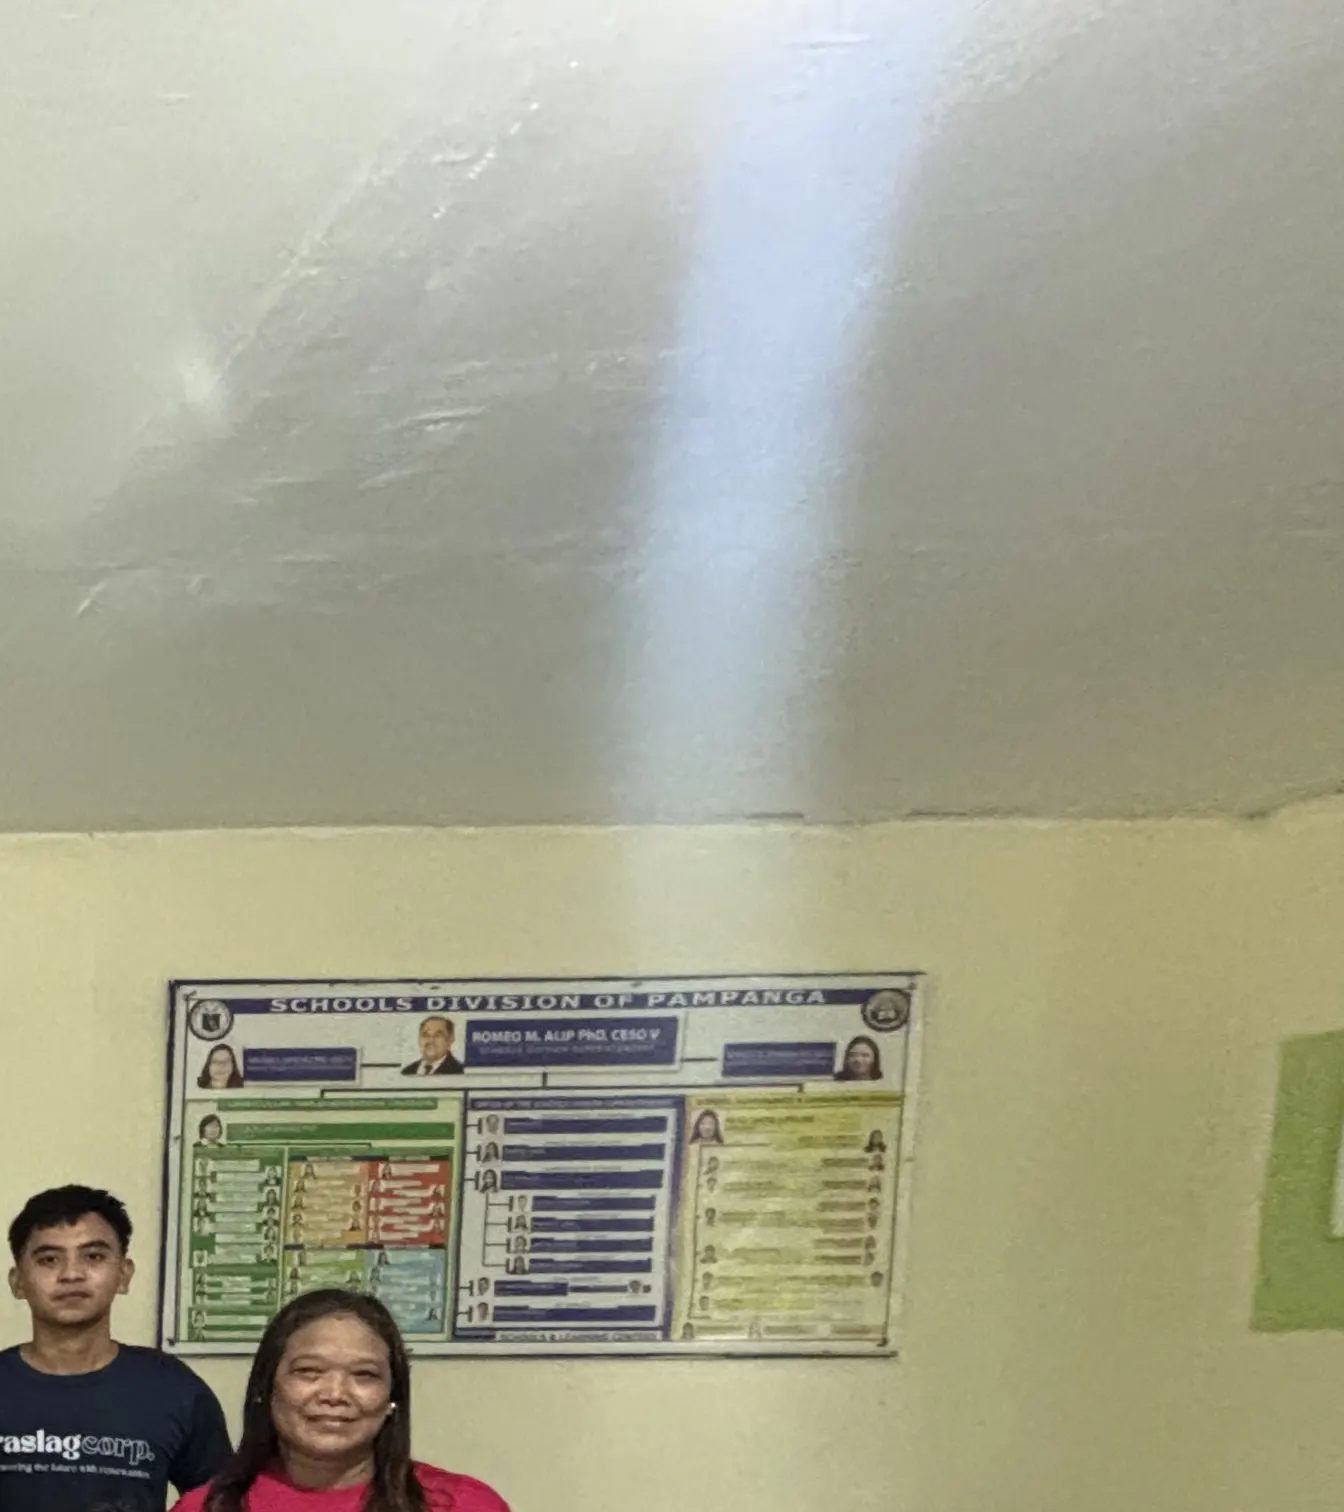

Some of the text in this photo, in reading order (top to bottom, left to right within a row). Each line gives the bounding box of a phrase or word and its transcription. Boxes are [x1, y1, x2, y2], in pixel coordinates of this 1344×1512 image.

[270, 989, 827, 1013] SCHOOLS DIVISION OF PAMPANGA
[472, 1030, 521, 1042] ROMEO
